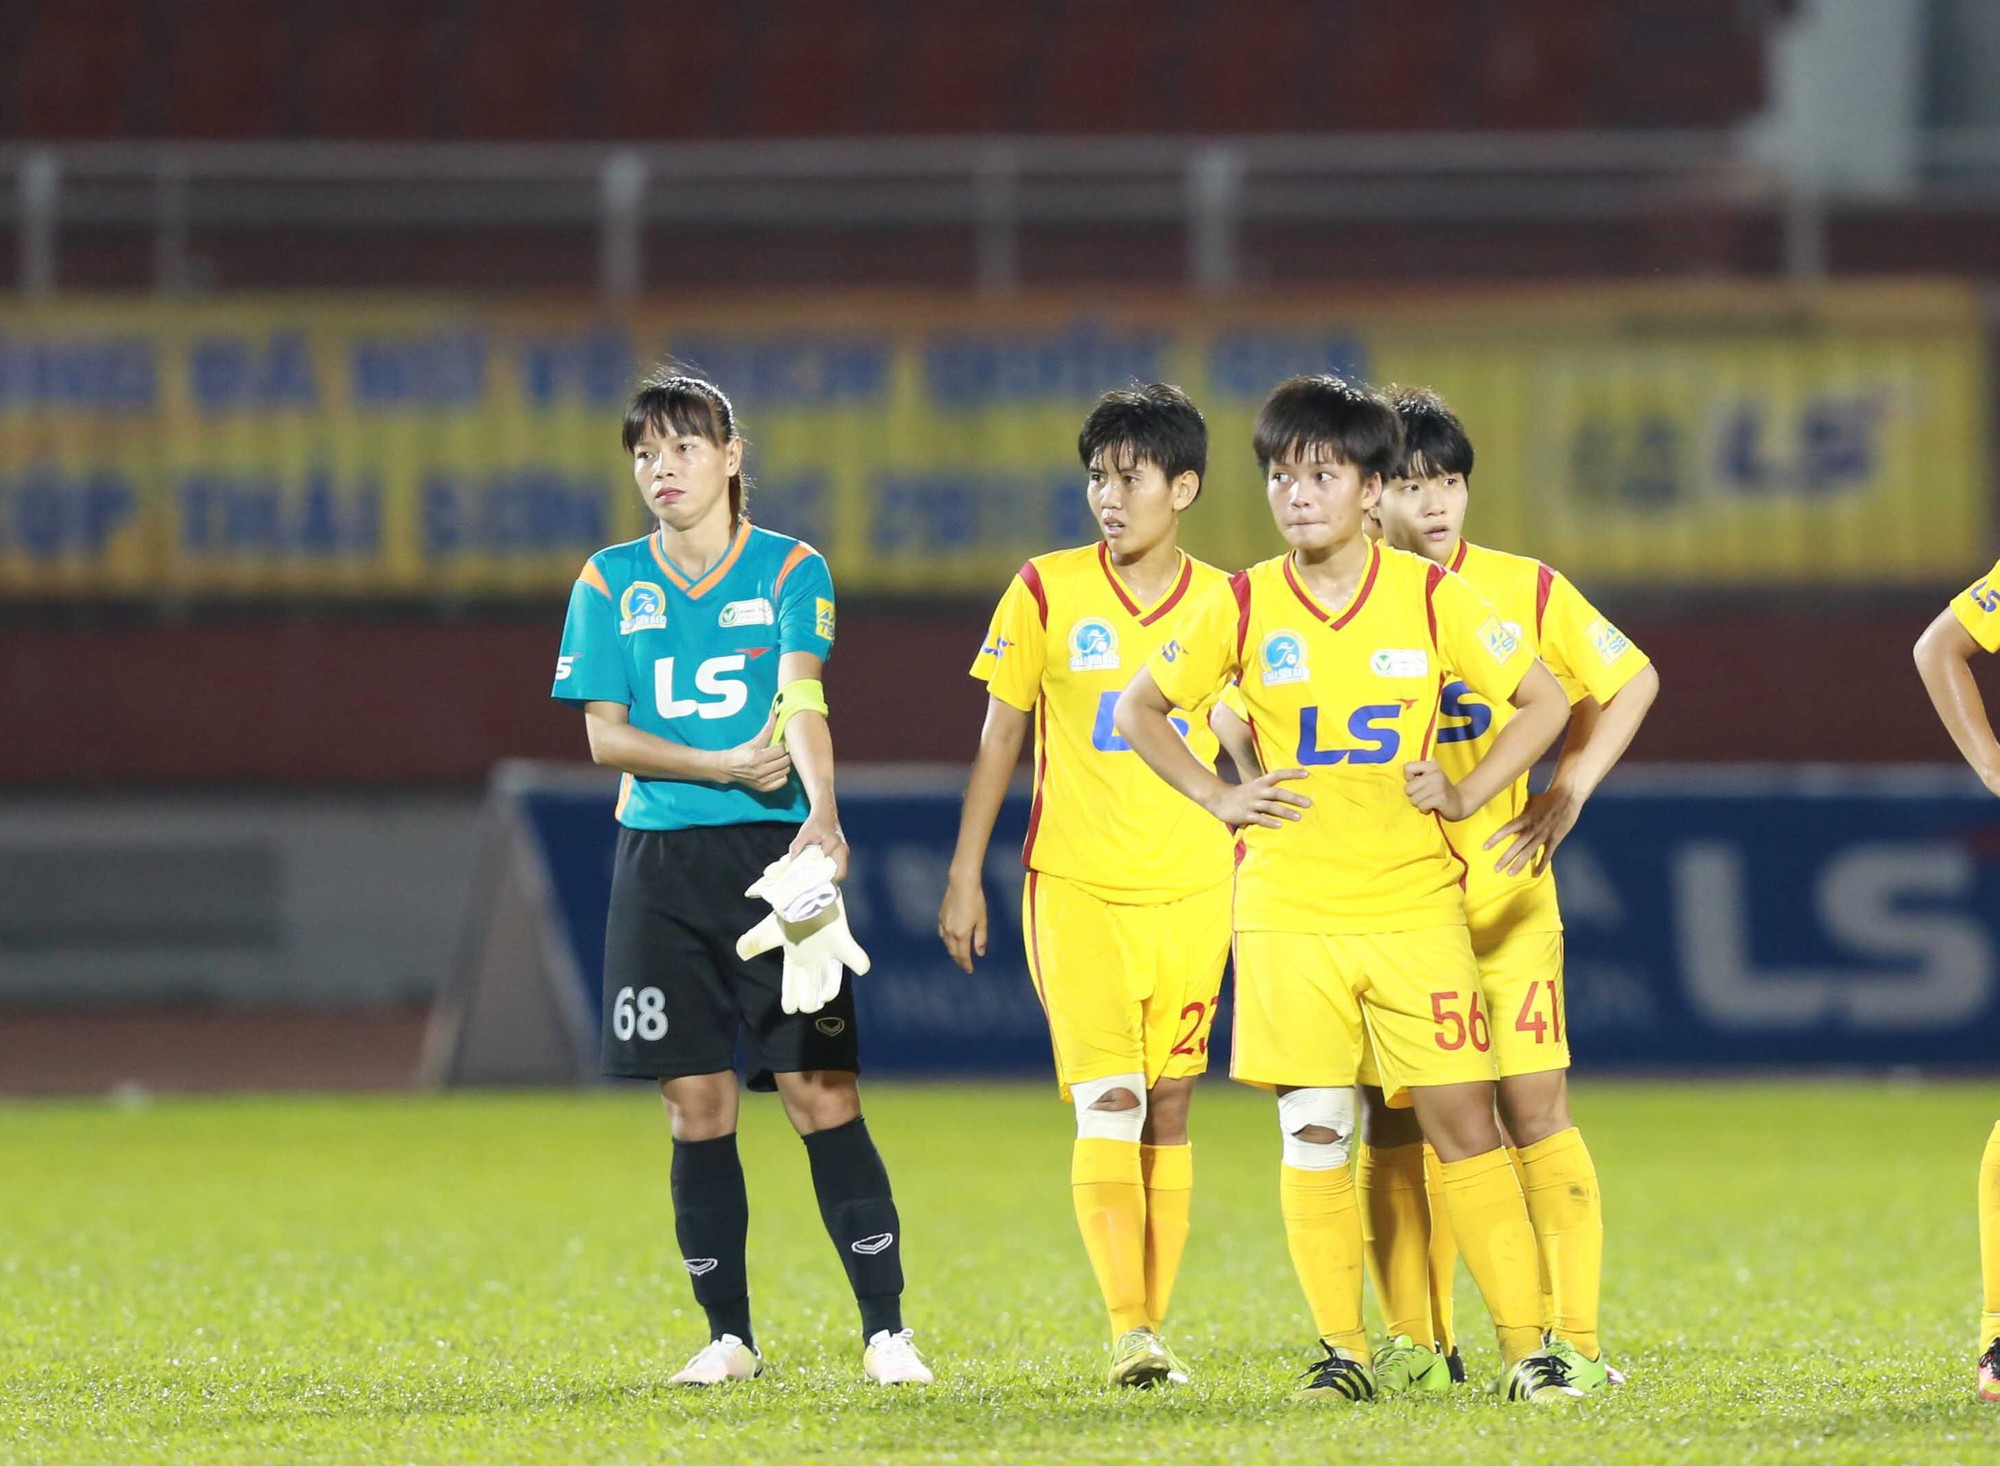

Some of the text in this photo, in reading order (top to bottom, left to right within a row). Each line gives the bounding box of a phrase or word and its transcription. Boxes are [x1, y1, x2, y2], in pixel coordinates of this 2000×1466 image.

[555, 656, 573, 680] S
[654, 655, 748, 719] LS
[1296, 704, 1401, 765] LS
[1437, 681, 1492, 743] S
[1675, 845, 1990, 1024] LS
[613, 986, 668, 1041] 68
[1430, 991, 1490, 1052] 56
[1515, 980, 1561, 1044] 41
